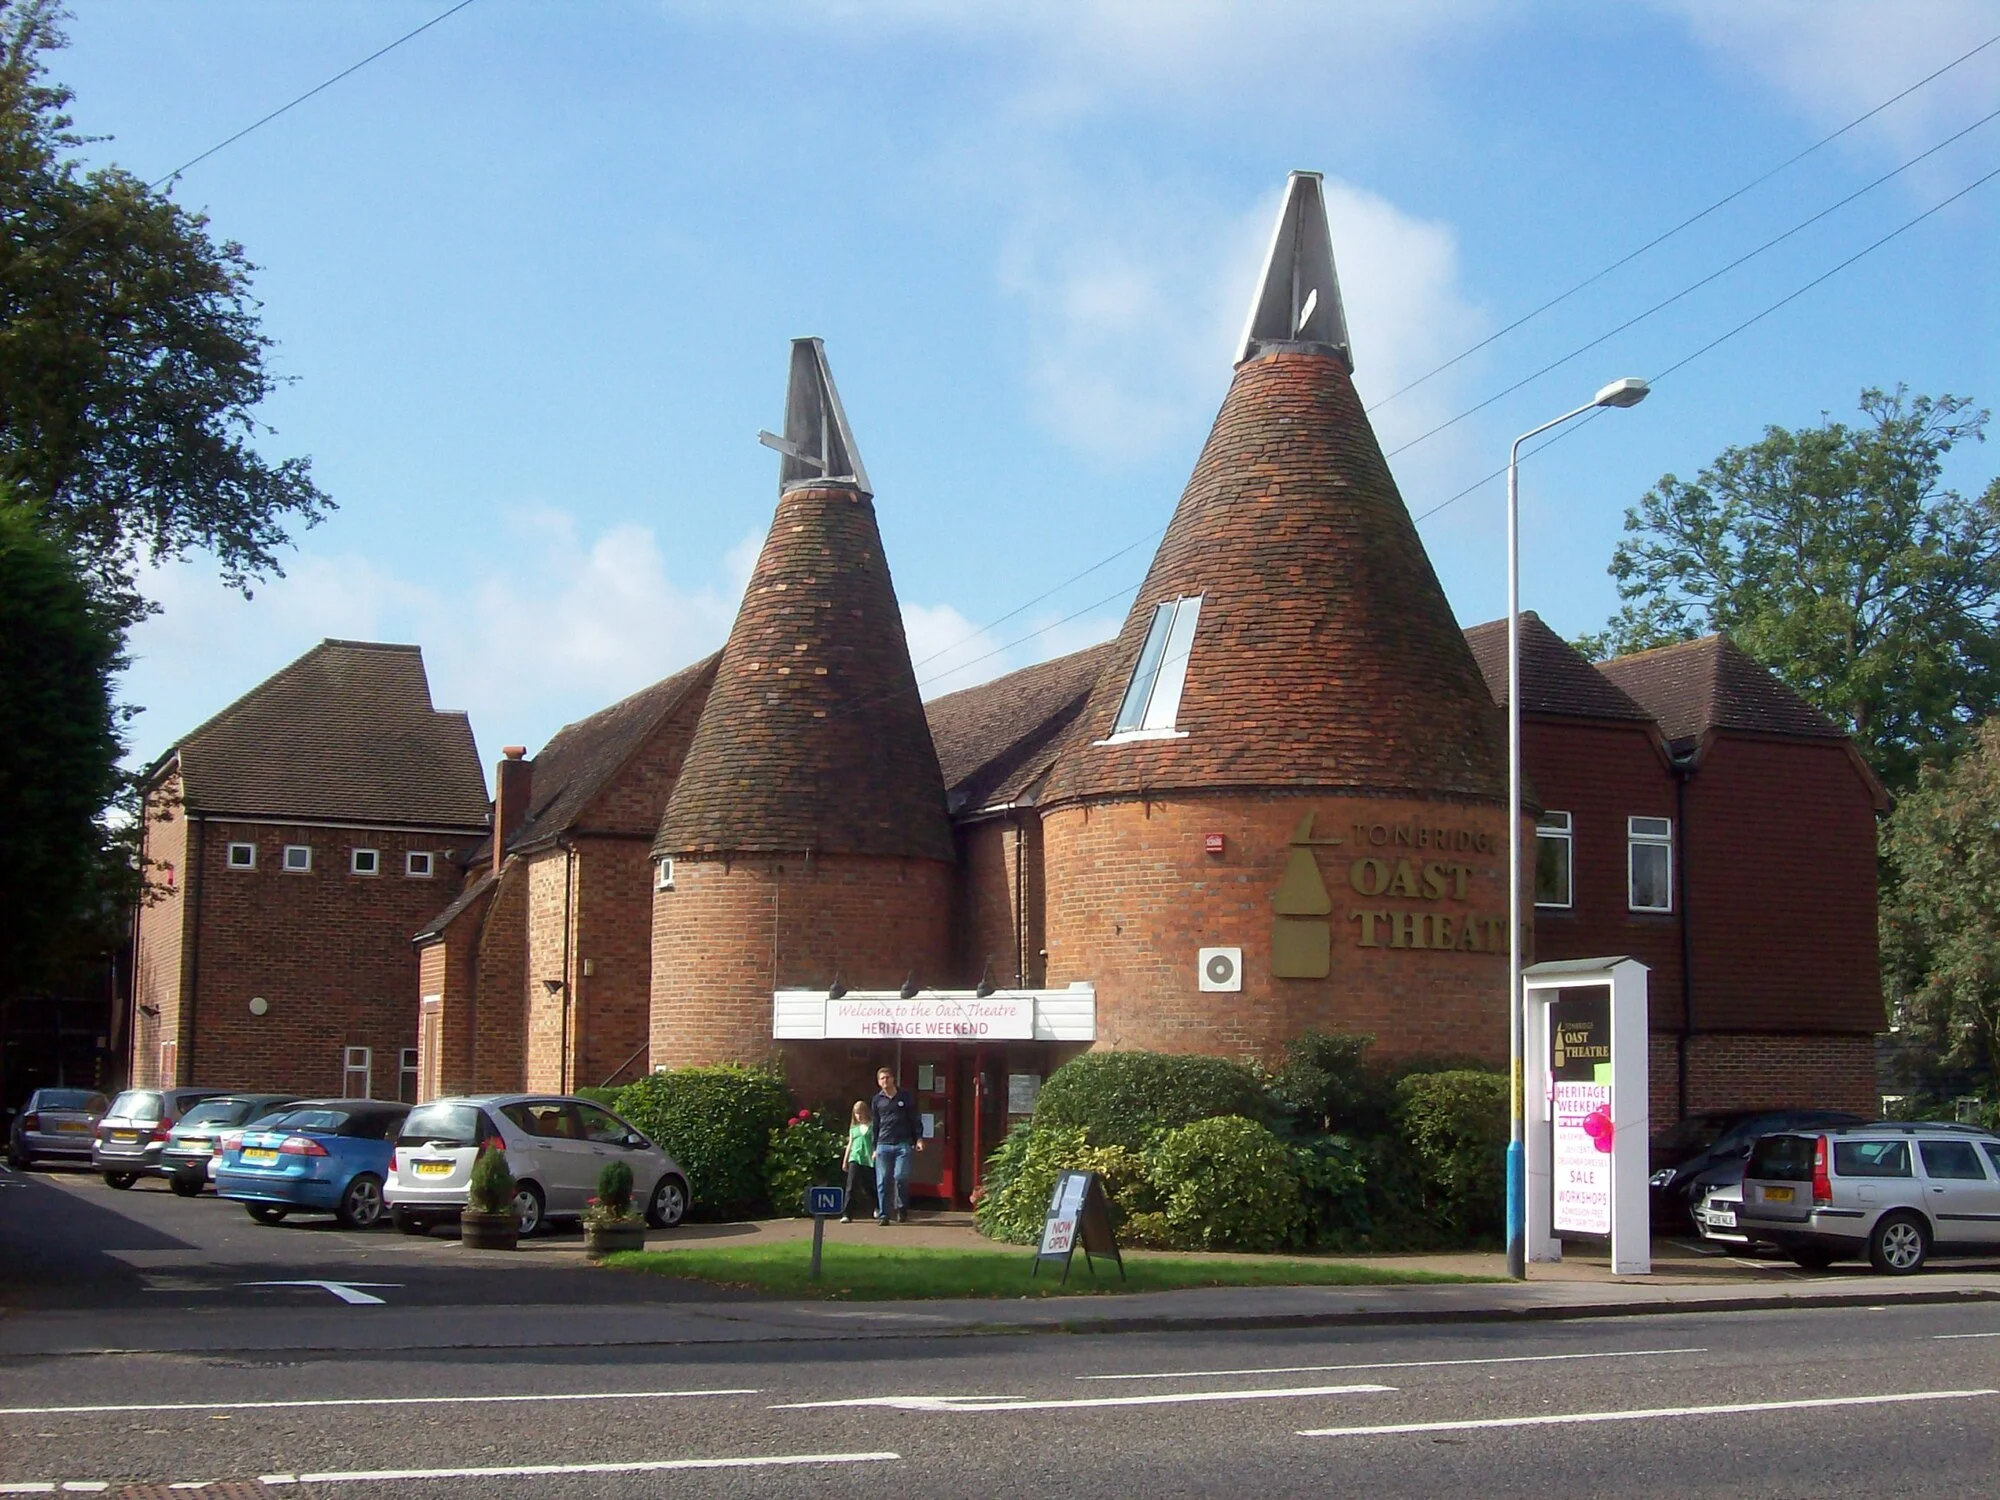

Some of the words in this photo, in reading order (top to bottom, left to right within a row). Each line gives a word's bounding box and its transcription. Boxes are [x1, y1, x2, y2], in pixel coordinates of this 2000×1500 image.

[1349, 857, 1475, 901] OAST
[838, 1002, 892, 1017] Welcome
[895, 1003, 908, 1017] to
[911, 1001, 931, 1017] the
[936, 1004, 961, 1017] Oast
[968, 1003, 1017, 1017] Theatre
[861, 1022, 922, 1035] HERITAGE
[925, 1022, 989, 1035] WEEKEND
[1565, 1032, 1589, 1044] OAST
[1565, 1046, 1609, 1057] THEATRE
[1558, 1086, 1605, 1098] HERITAGE
[1570, 1170, 1594, 1184] SALE
[818, 1194, 835, 1208] IN
[1559, 1190, 1607, 1206] WORKSHOPS
[1052, 1221, 1073, 1235] NOW
[1048, 1236, 1069, 1250] OPEN
